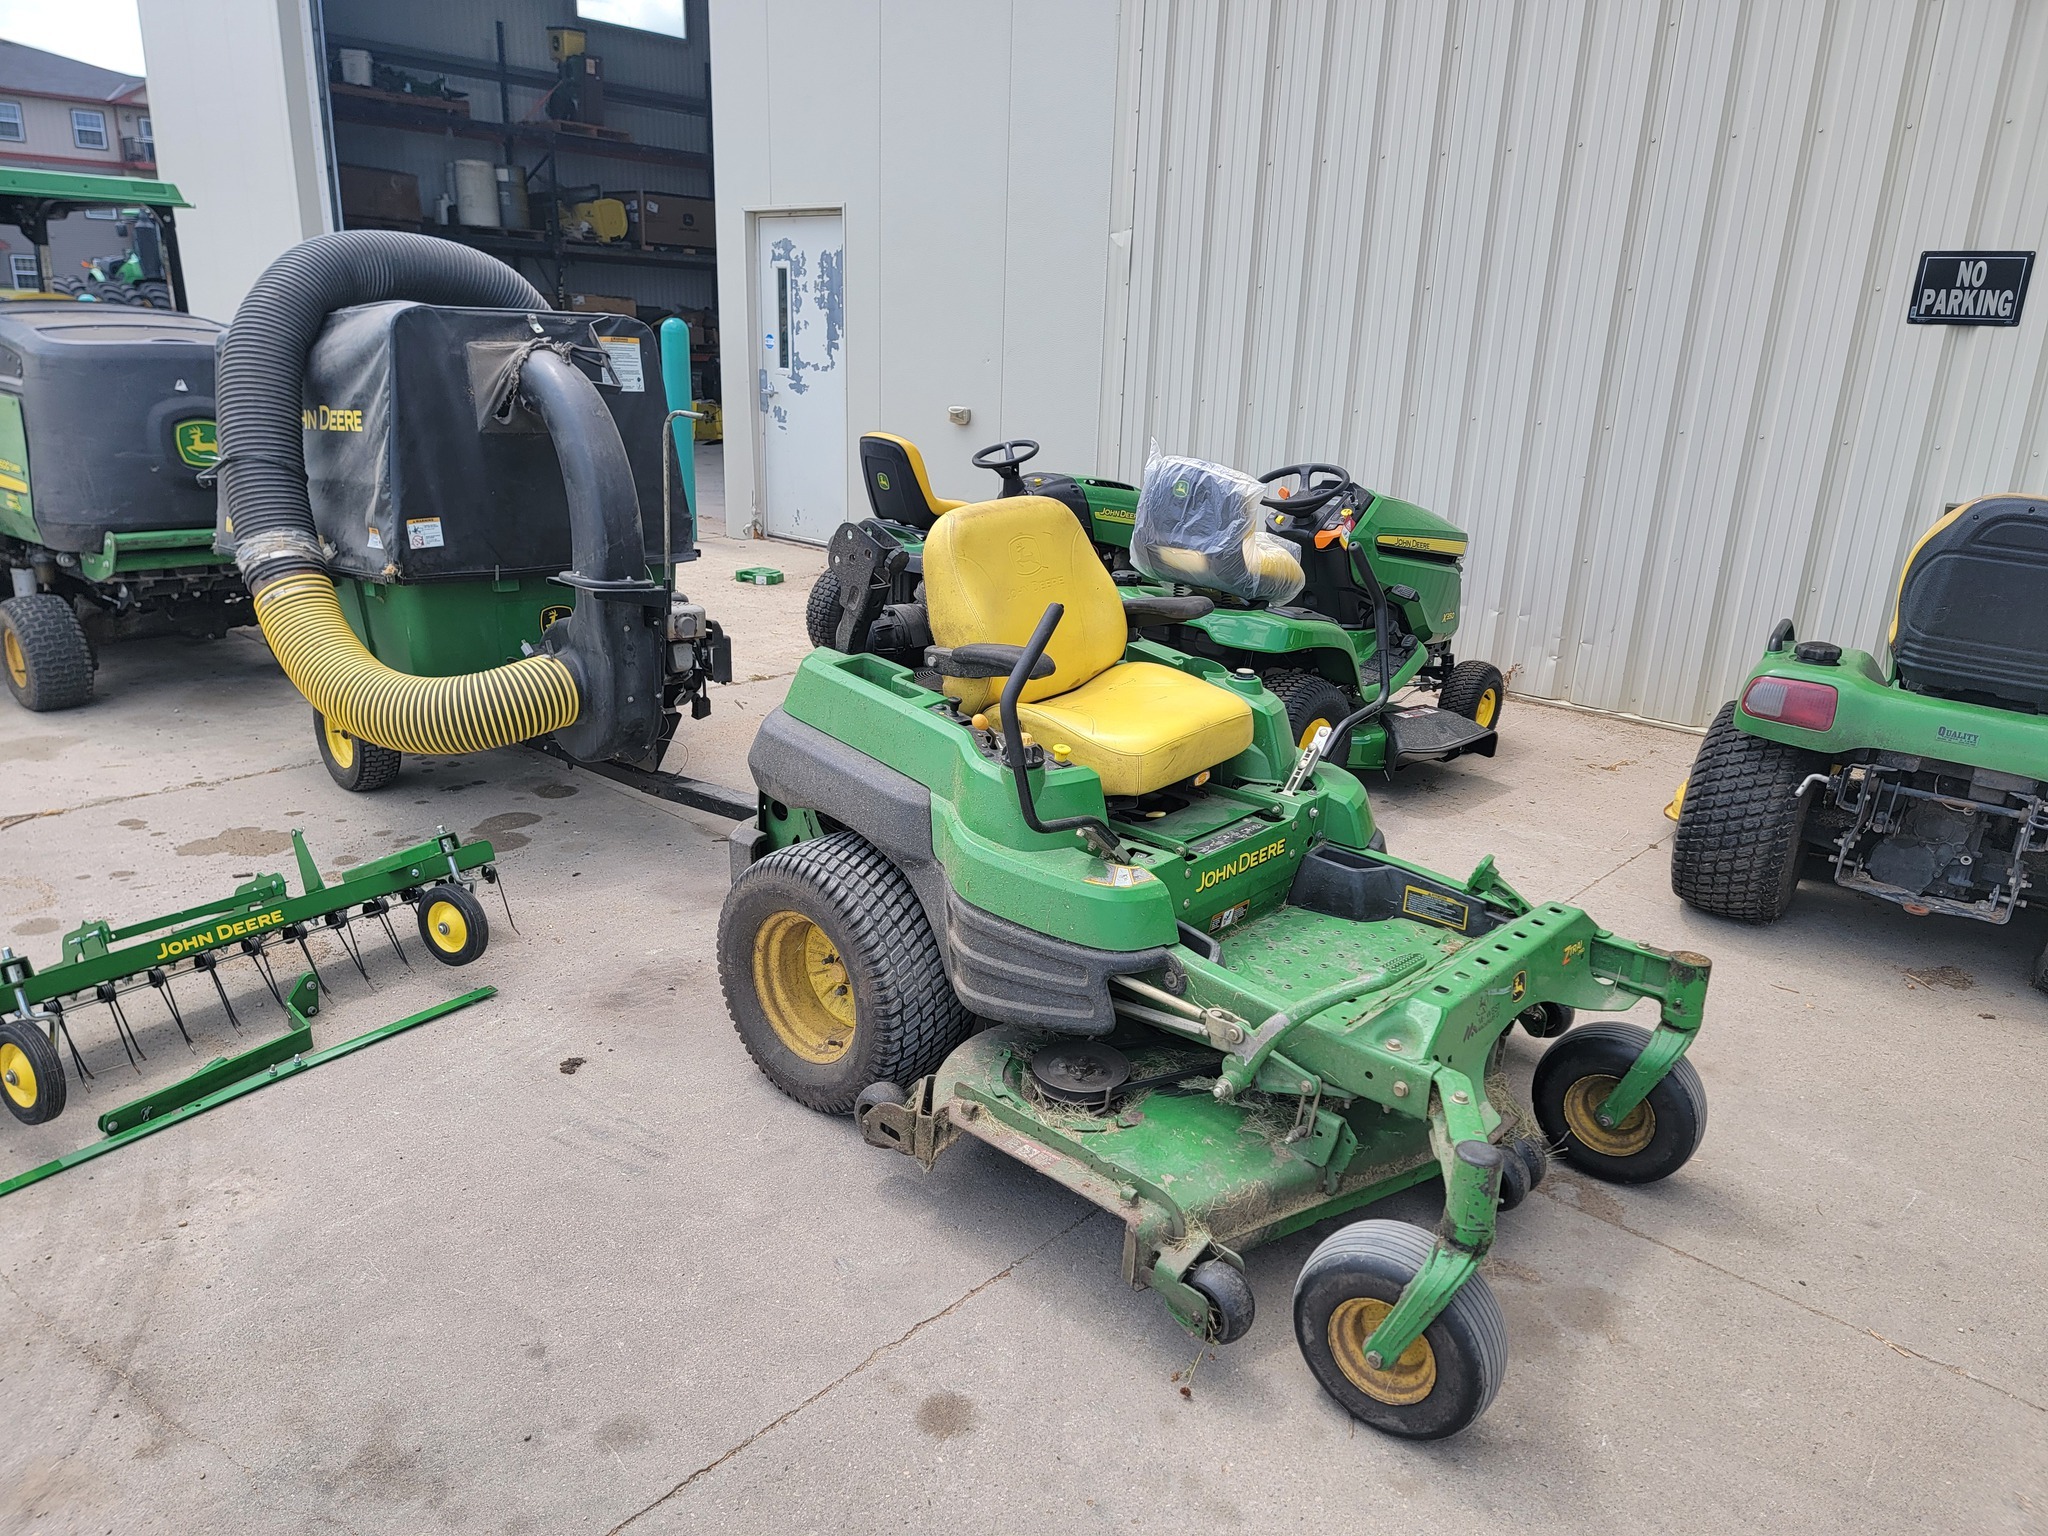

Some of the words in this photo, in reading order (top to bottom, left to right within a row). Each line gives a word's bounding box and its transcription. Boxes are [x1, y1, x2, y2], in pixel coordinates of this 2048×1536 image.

[1955, 260, 1988, 288] NO
[1919, 288, 2014, 317] PARKING
[319, 405, 363, 432] DEERE
[1100, 507, 1120, 517] JOHN
[1120, 509, 1137, 519] DEE
[1395, 538, 1411, 547] JOHN
[1412, 539, 1430, 550] DEERE
[1937, 726, 1979, 742] QUALITY
[1195, 860, 1237, 893] JOHN
[1238, 838, 1286, 873] DEERE
[156, 931, 214, 960] JOHN
[216, 909, 285, 940] DEERE
